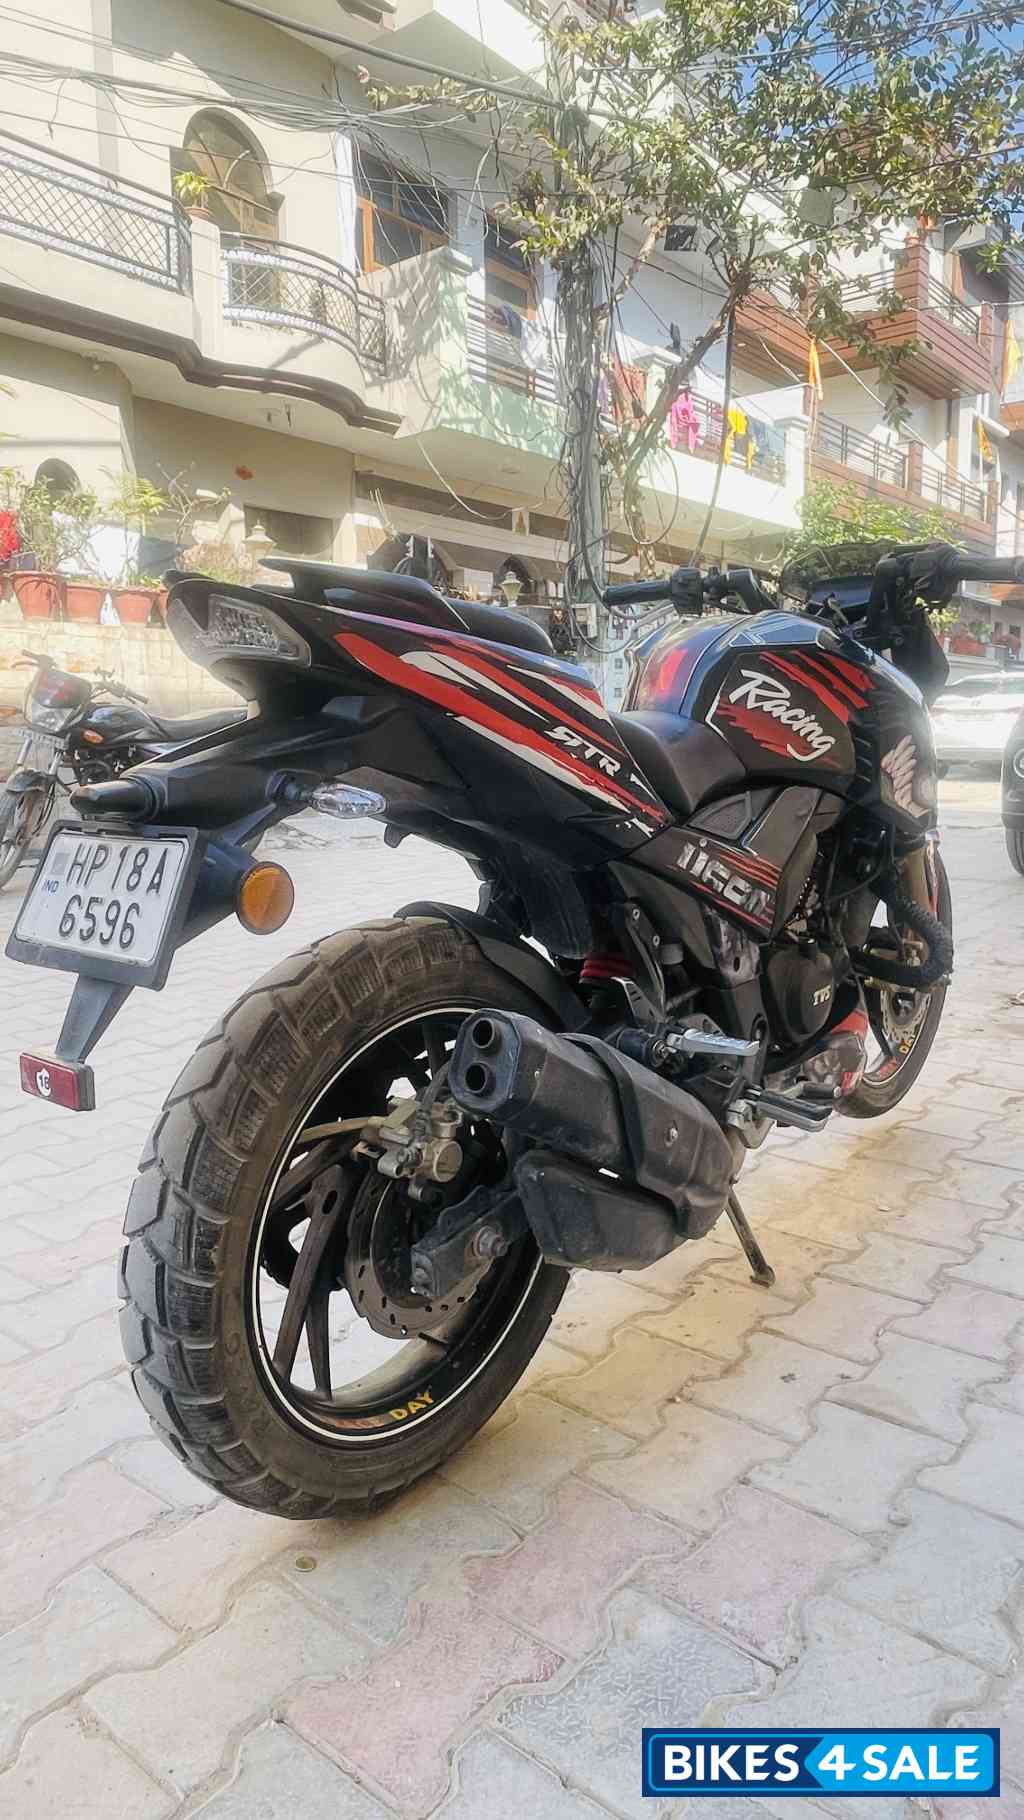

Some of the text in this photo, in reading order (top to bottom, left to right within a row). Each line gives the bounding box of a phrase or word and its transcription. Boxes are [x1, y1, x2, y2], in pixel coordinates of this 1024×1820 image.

[728, 669, 836, 761] Racing
[41, 879, 60, 894] IND
[58, 894, 141, 949] 6596
[389, 1390, 434, 1420] DAY
